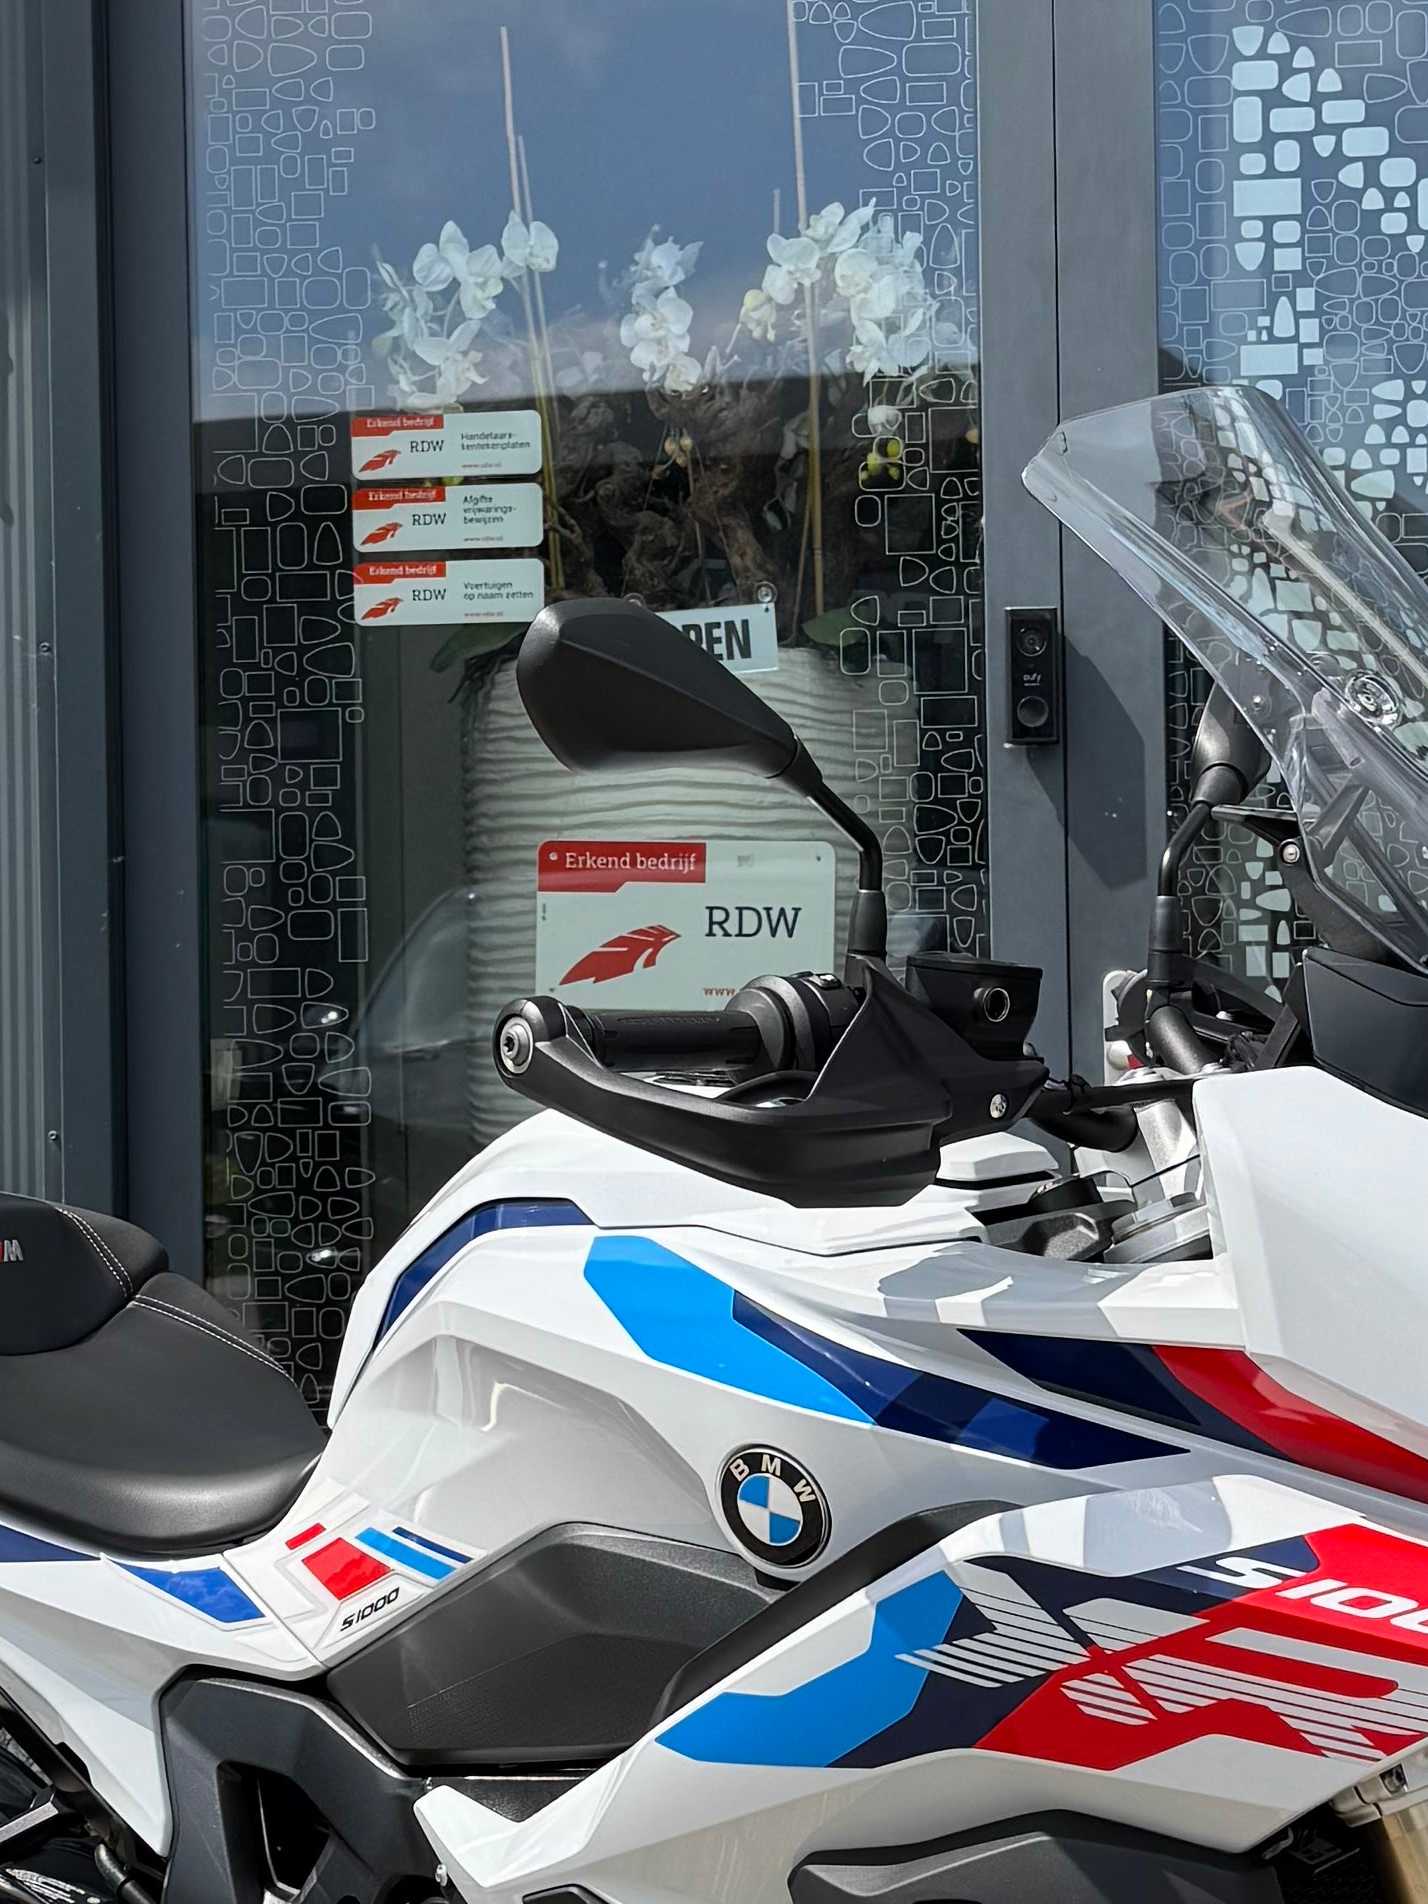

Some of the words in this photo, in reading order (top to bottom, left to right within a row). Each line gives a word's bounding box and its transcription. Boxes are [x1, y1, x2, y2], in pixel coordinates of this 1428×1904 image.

[367, 417, 401, 428] Erkend
[403, 416, 435, 428] bedrijf
[410, 440, 444, 453] RDW
[412, 513, 446, 526] RDW
[369, 566, 403, 576] Erkend
[406, 565, 437, 576] bedrijf
[412, 589, 446, 601] RDW
[463, 592, 475, 601] op
[477, 592, 503, 600] naam
[681, 619, 752, 661] PEN
[565, 852, 631, 870] Erkend
[637, 852, 696, 873] bedrijf
[705, 906, 802, 938] RDW
[729, 1454, 816, 1503] BMW
[340, 1586, 400, 1632] S1000
